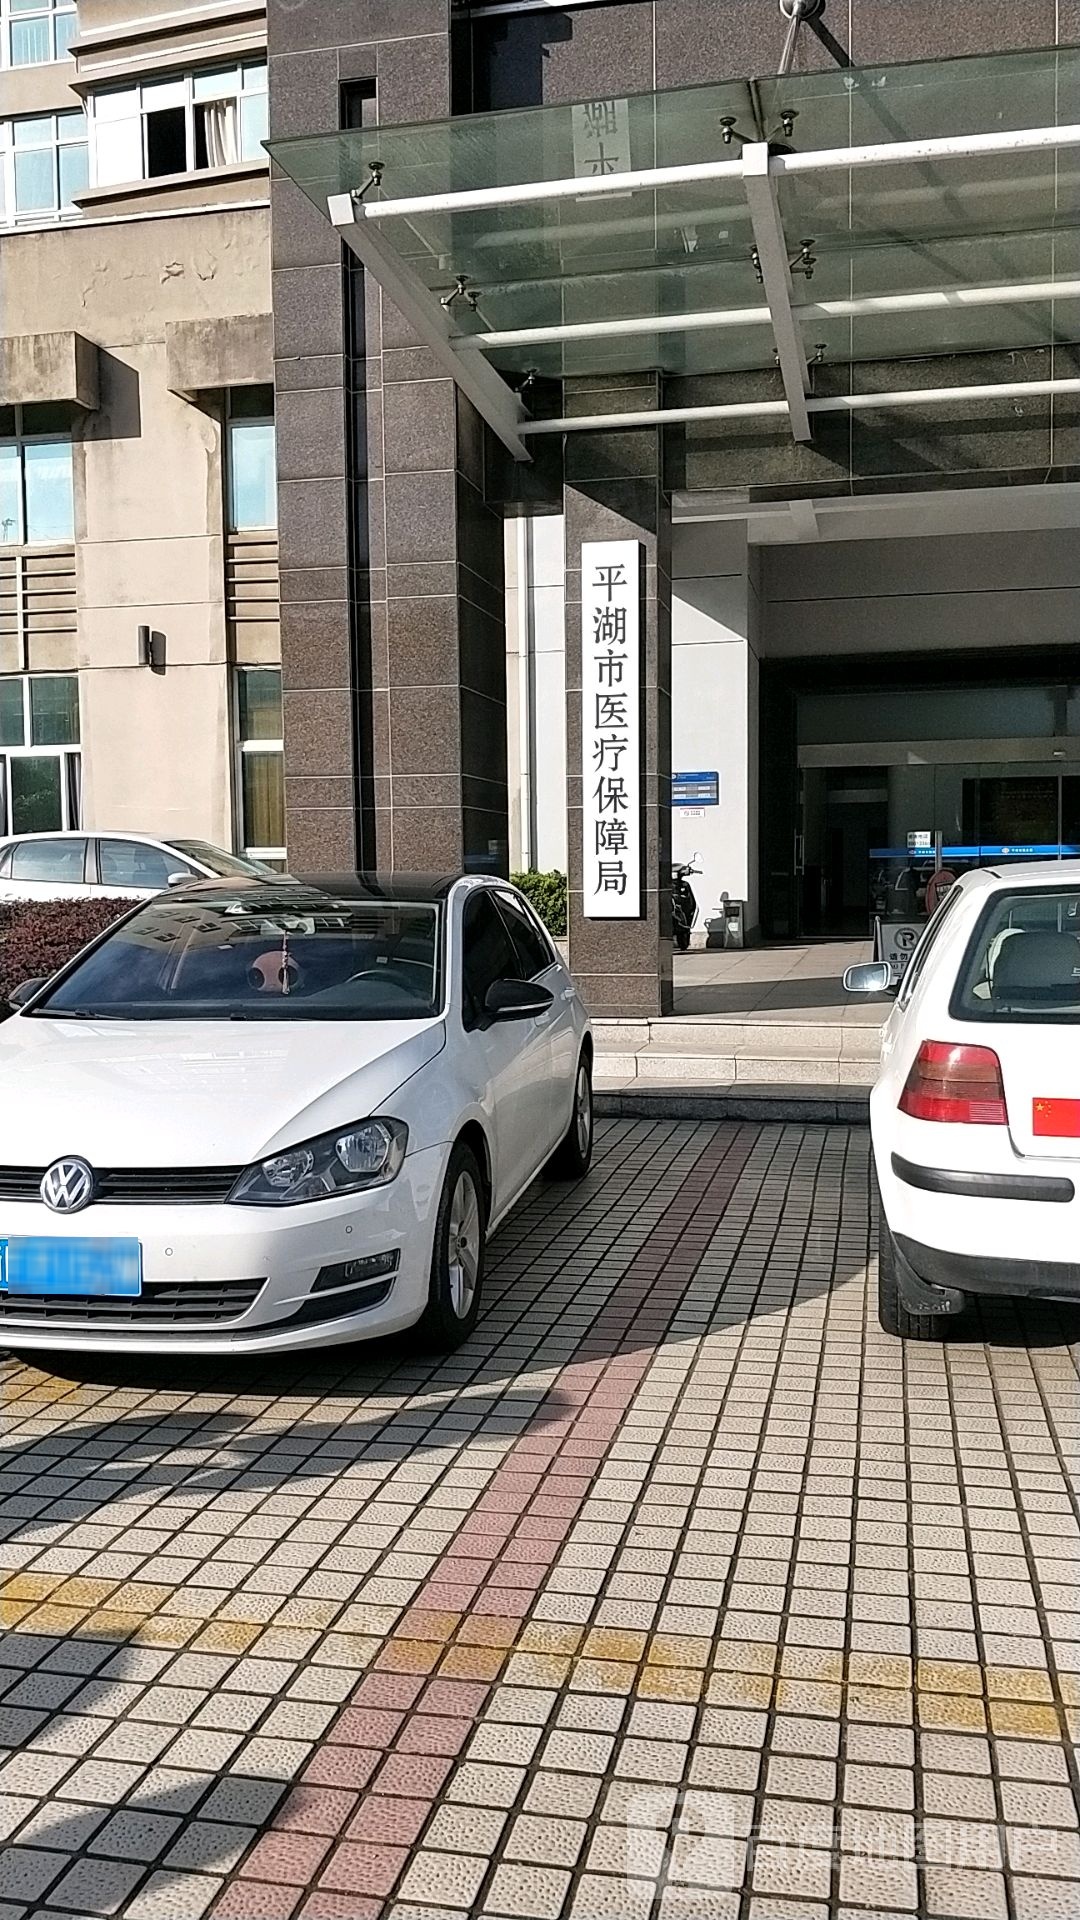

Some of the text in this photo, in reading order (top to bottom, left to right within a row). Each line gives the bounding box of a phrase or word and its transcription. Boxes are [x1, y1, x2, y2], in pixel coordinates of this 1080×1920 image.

[592, 563, 628, 896] 平湖市医疗保障局
[889, 952, 913, 960] 请勿
